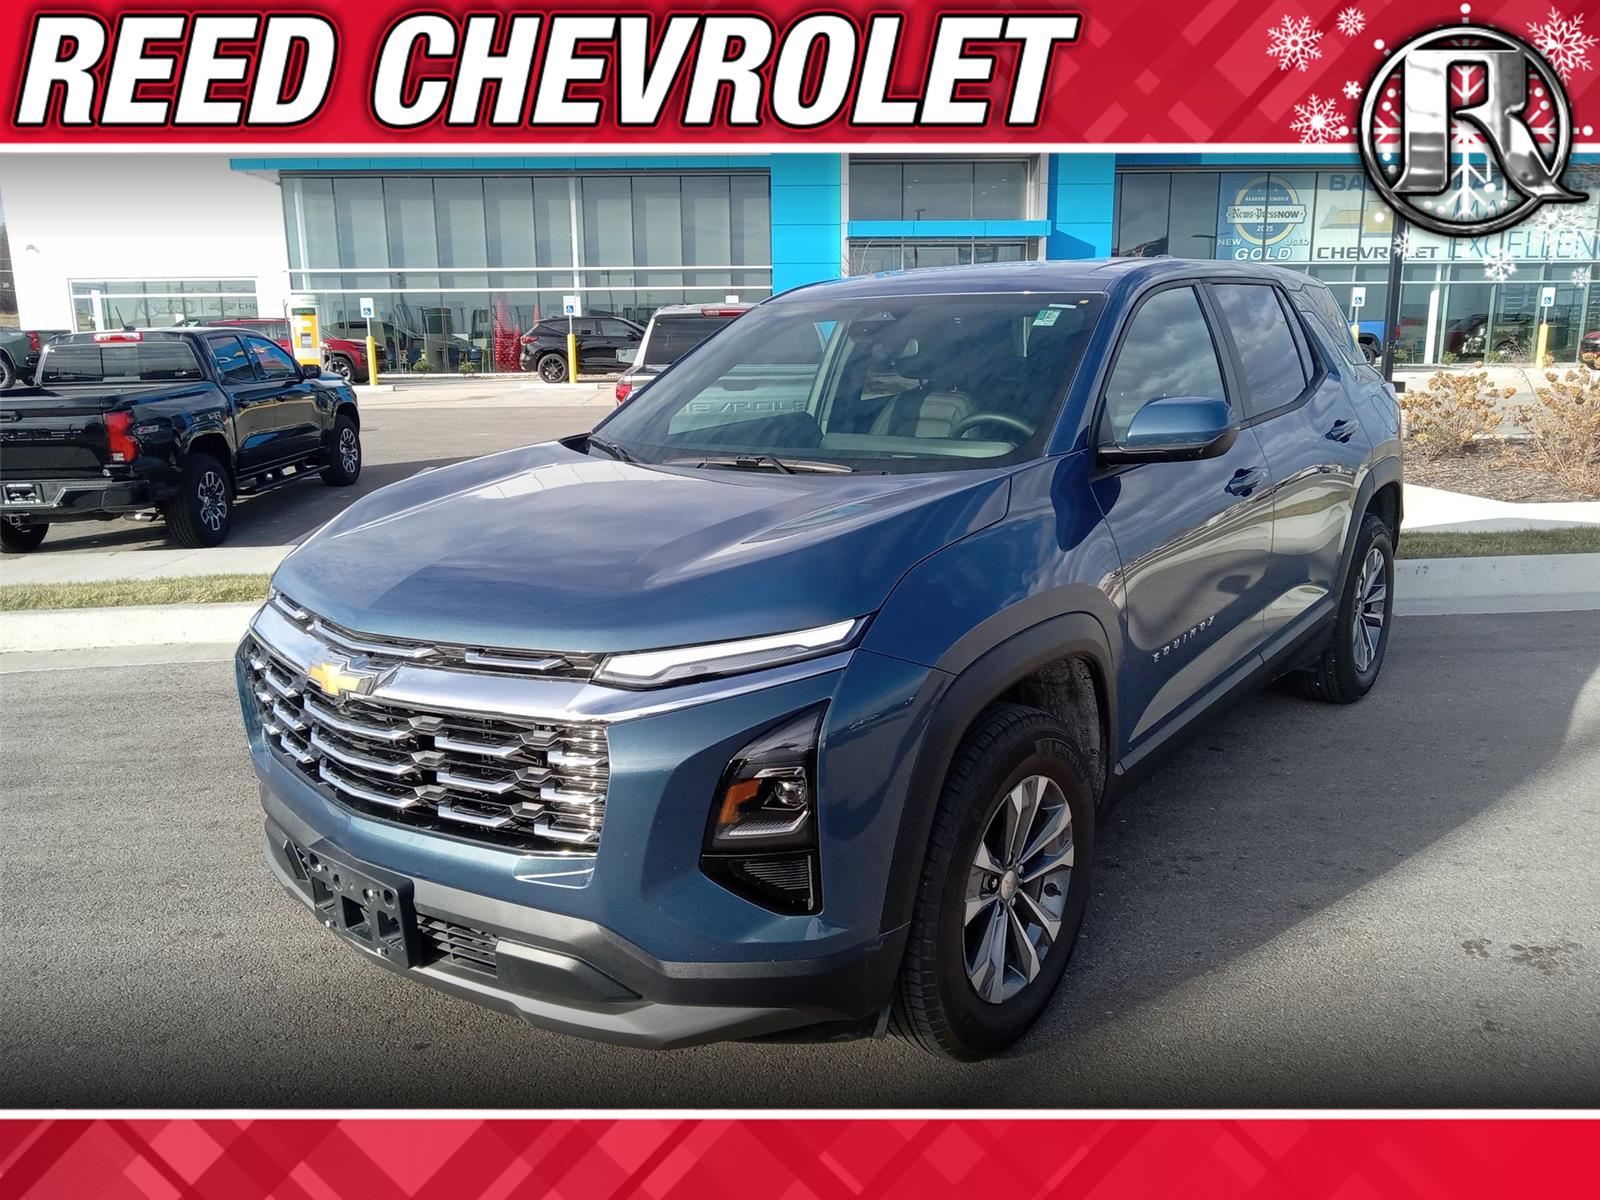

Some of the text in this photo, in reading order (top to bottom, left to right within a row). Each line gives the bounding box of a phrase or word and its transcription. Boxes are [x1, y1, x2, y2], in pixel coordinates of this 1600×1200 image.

[1217, 238, 1309, 246] NEW USED
[1447, 230, 1600, 258] EXCELLEN
[1234, 247, 1292, 260] GOLD
[1317, 246, 1439, 259] CHEVRET
